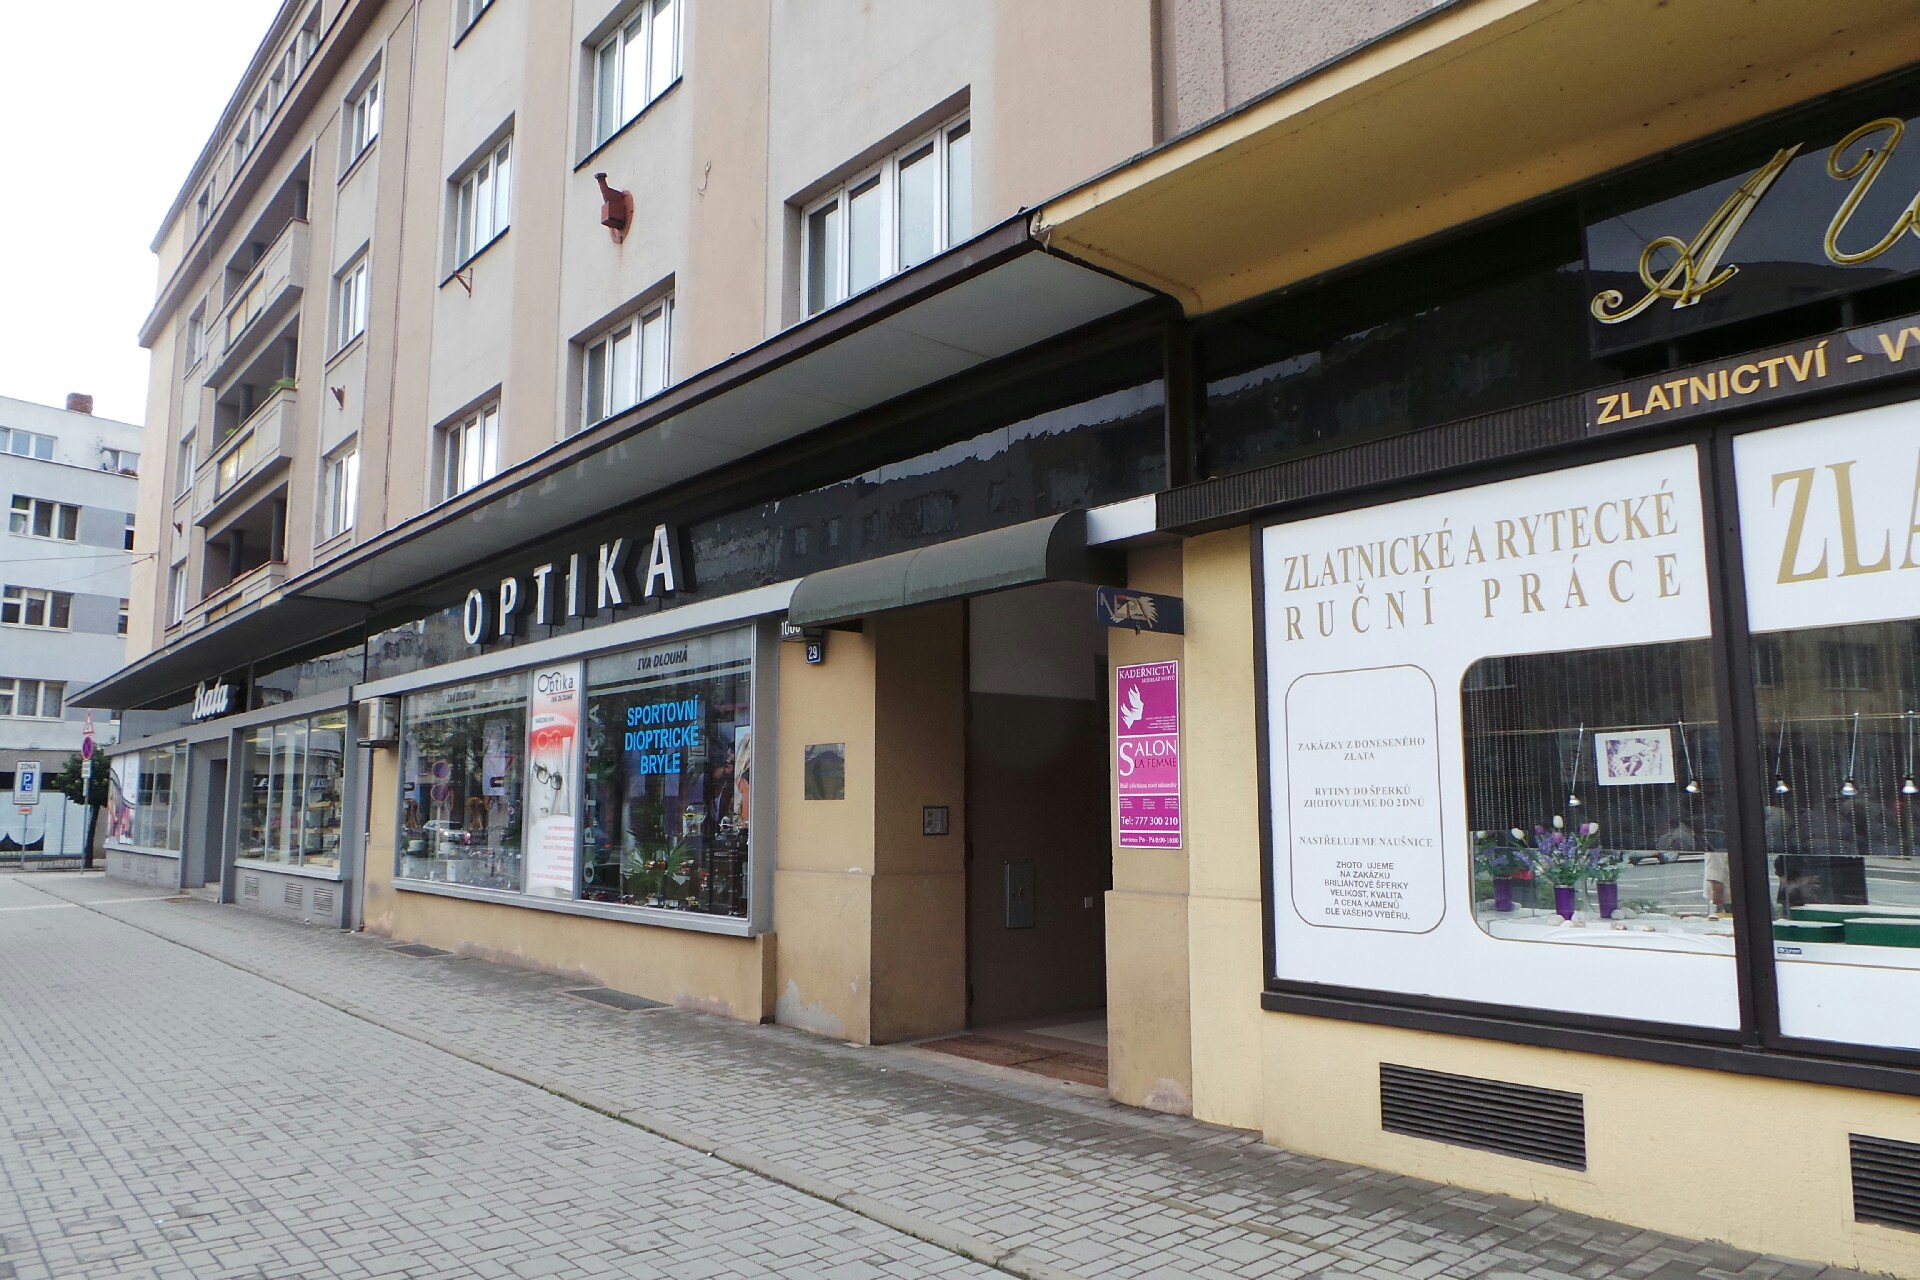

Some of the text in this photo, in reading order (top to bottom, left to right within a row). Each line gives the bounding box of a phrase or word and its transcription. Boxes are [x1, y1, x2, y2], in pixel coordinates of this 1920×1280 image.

[1597, 340, 1829, 425] ZLATNICTVÍ
[1284, 478, 1678, 592] ZLATNICKÉ A RYTECKÉ
[463, 523, 675, 645] OPTIKA
[1284, 552, 1681, 642] RUČNÍ PRÁCE
[637, 645, 688, 671] IVA DLOUHÁ
[808, 645, 818, 660] 29
[1119, 663, 1176, 680] KADEŘNICTVÍ
[538, 671, 574, 692] Optika
[627, 694, 699, 727] SPORTOVNÍ
[625, 720, 699, 751] DIOPTRICKÉ
[1298, 740, 1343, 751] ZAKÁZKY
[1354, 735, 1426, 749] DONESENÉHO
[640, 750, 681, 775] BRÝLE
[1147, 757, 1177, 768] FEMME
[1343, 751, 1376, 761] ZLATA
[1314, 783, 1412, 796] RYTINY DO ŠPERKŮ
[1303, 798, 1378, 808] ZHOTOVUJEME
[1379, 799, 1394, 808] DO
[1135, 816, 1149, 826] 777
[1149, 816, 1163, 826] 300
[1164, 816, 1179, 826] 210
[1299, 834, 1434, 848] NASTŘELUJEME NAUŠNICE
[1340, 869, 1391, 880] NA ZAKÁZKU
[1324, 878, 1409, 890] BRILIANTOVÉ ŠPERKY
[1330, 888, 1403, 900] VELIKOST, KVALITA
[1334, 898, 1400, 910] A CENA KAMENŮ
[1325, 907, 1340, 916] DLE
[1341, 908, 1373, 918] VAŠEHO
